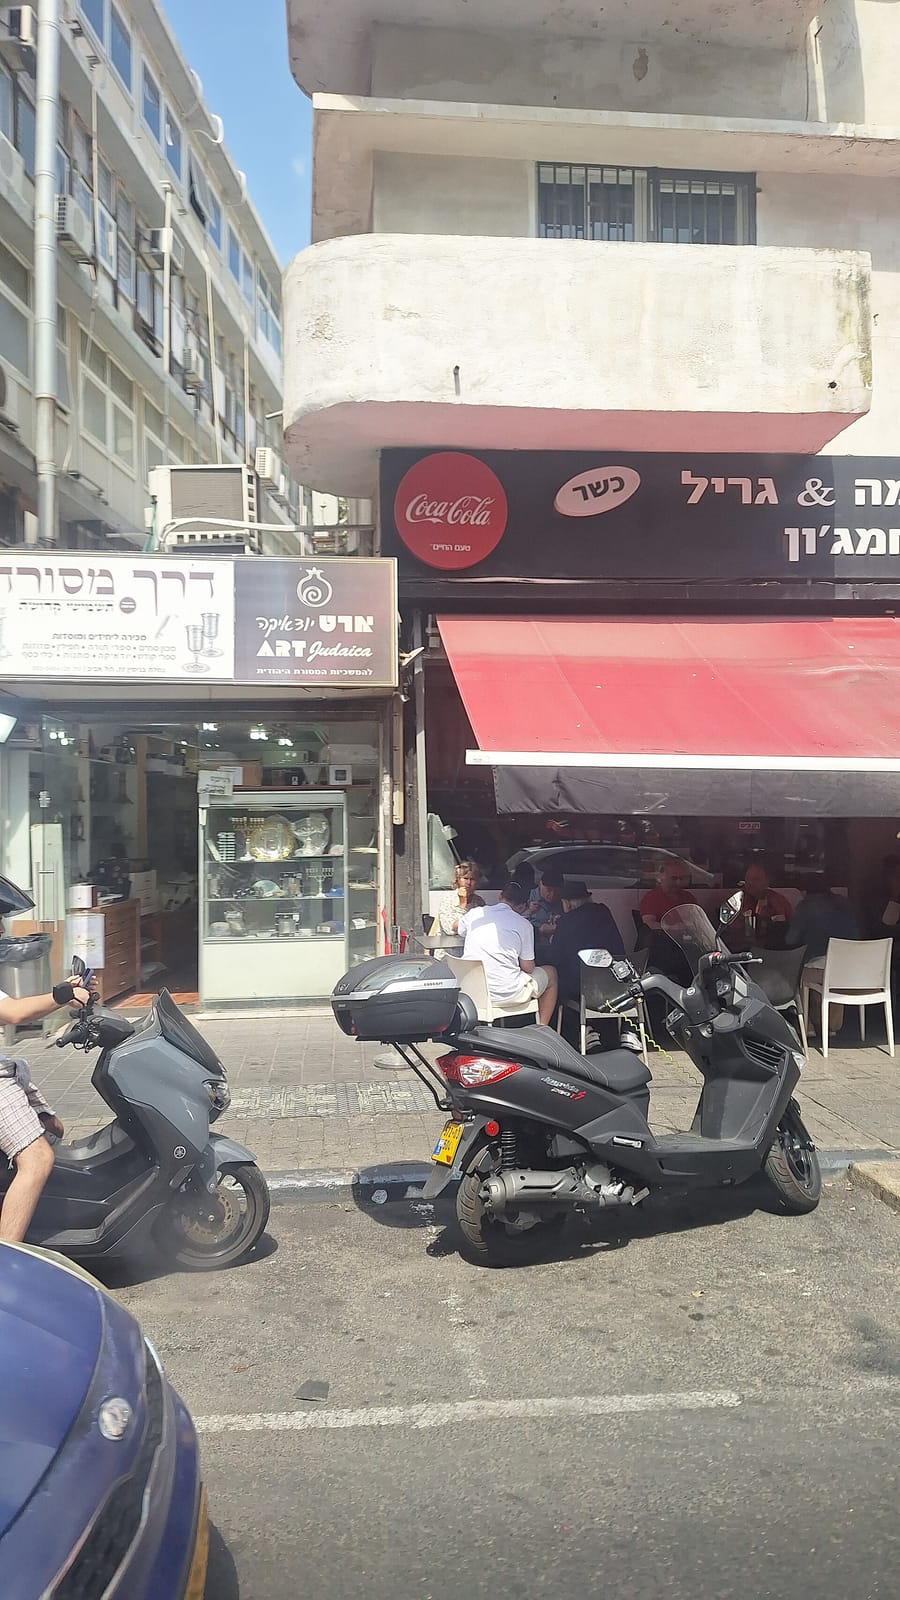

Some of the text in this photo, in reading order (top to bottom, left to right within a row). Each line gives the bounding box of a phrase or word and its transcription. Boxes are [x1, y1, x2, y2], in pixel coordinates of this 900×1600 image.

[571, 476, 625, 502] כשר
[681, 470, 780, 505] גריל
[796, 477, 837, 507] &
[405, 493, 496, 526] Coca-Cola
[453, 543, 471, 552] טעם
[132, 569, 215, 617] דרך
[255, 614, 374, 638] ארט יודאיקה
[256, 639, 373, 663] ART Judaica
[255, 667, 373, 677] להמשכיות המסורת היהודית
